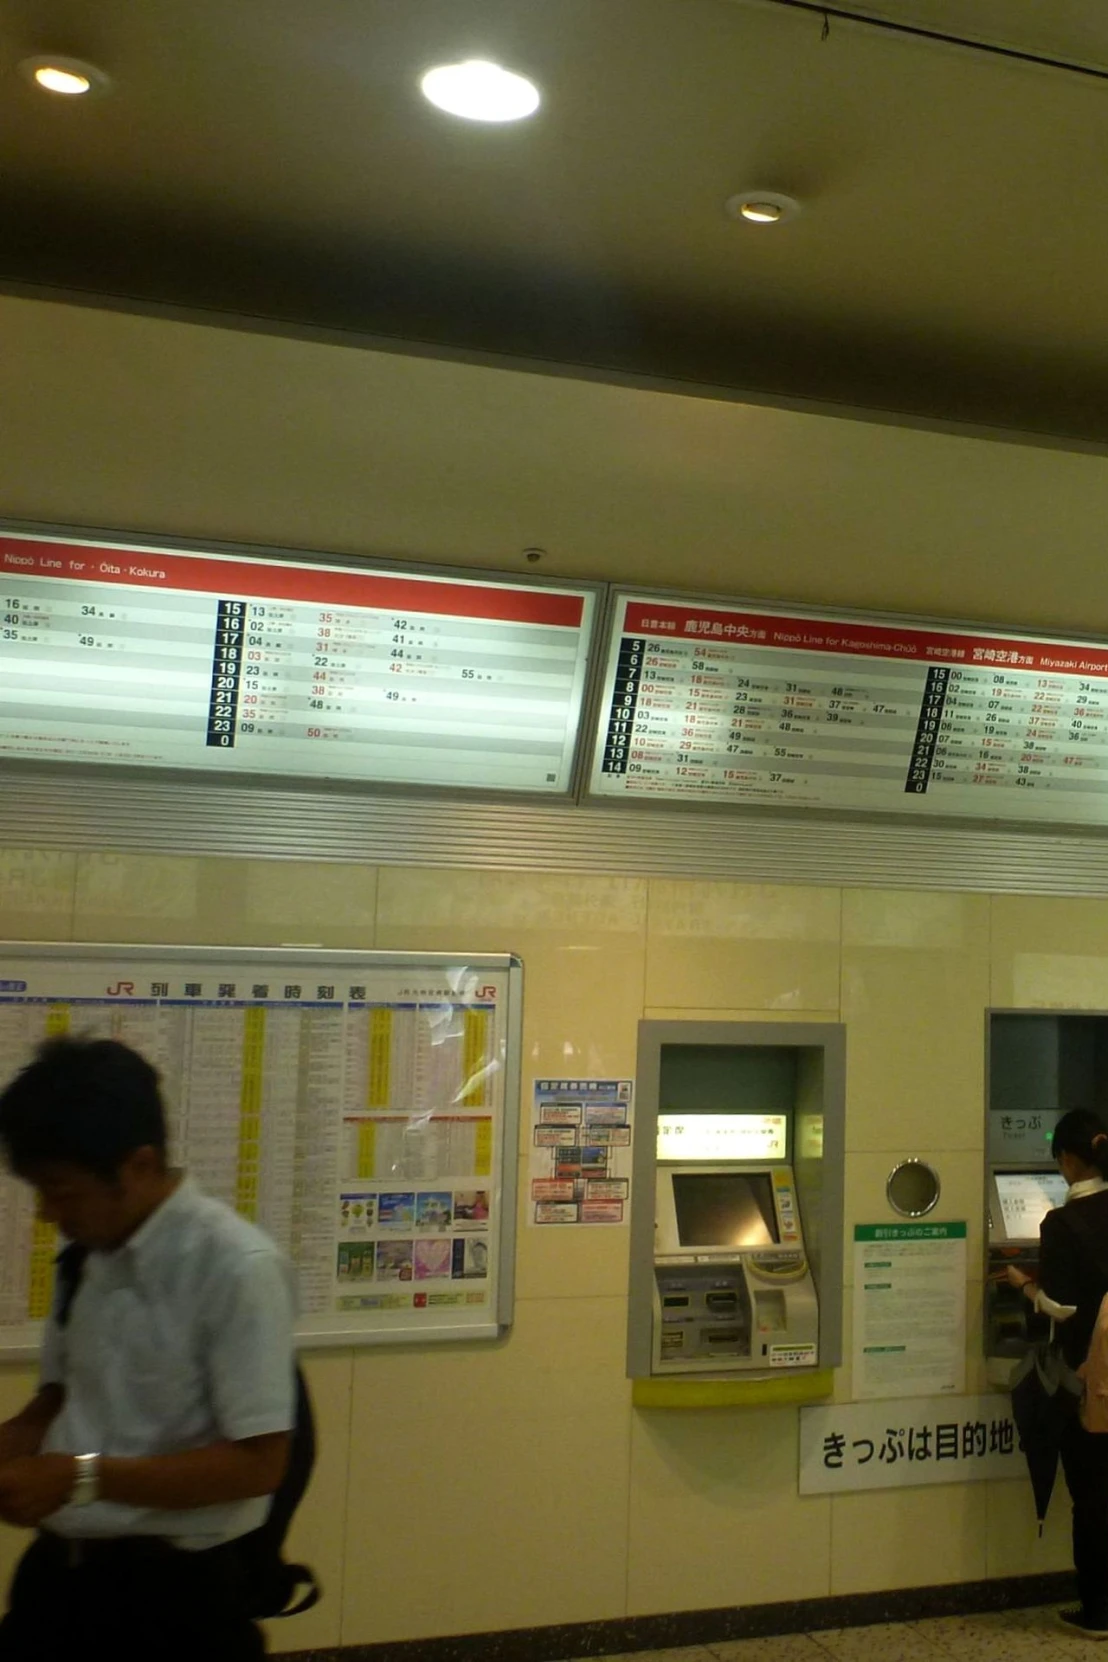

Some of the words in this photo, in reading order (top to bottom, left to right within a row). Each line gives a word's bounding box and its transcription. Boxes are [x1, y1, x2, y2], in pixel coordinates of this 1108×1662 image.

[40, 559, 62, 568] Line
[69, 560, 85, 569] for
[129, 567, 166, 578] Kokura
[5, 600, 19, 609] 16
[82, 606, 95, 615] 34
[4, 614, 18, 625] 40
[225, 603, 241, 615] 15
[252, 607, 265, 617] 13
[319, 613, 332, 622] 35
[394, 620, 407, 630] 42
[3, 630, 18, 640] 35
[80, 636, 94, 646] 49
[223, 618, 240, 630] 16
[250, 622, 264, 631] 02
[318, 628, 330, 637] 38
[392, 635, 404, 644] 41
[223, 633, 238, 644] 17
[249, 637, 262, 646] 04
[316, 643, 328, 652] 31
[391, 649, 403, 658] 44
[632, 641, 640, 651] 5
[648, 644, 660, 652] 26
[694, 648, 706, 656] 54
[803, 635, 823, 645] Line
[826, 638, 839, 646] for
[222, 648, 237, 659] 18
[248, 651, 261, 660] 03
[315, 657, 328, 667] 22
[389, 664, 402, 673] 42
[461, 670, 474, 679] 55
[630, 655, 638, 665] 6
[646, 657, 658, 666] 26
[692, 662, 704, 670] 58
[1040, 658, 1077, 669] Miyazaki
[1079, 662, 1108, 672] Airport
[220, 663, 236, 674] 19
[246, 666, 260, 675] 23
[313, 672, 326, 680] 44
[629, 669, 636, 679] 7
[645, 671, 656, 679] 13
[738, 679, 749, 687] 24
[786, 683, 797, 692] 31
[934, 670, 945, 679] 15
[1079, 683, 1090, 691] 34
[218, 678, 234, 688] 20
[245, 680, 258, 690] 15
[312, 686, 325, 695] 38
[386, 692, 399, 700] 49
[931, 682, 943, 691] 16
[1034, 692, 1045, 700] 22
[216, 692, 232, 703] 21
[244, 696, 257, 704] 20
[310, 700, 323, 710] 48
[624, 696, 632, 706] 9
[686, 702, 697, 710] 21
[734, 706, 745, 714] 28
[626, 682, 634, 693] 8
[642, 684, 654, 692] 00
[736, 693, 747, 701] 23
[829, 700, 841, 708] 37
[873, 705, 884, 713] 47
[929, 696, 940, 704] 17
[215, 707, 231, 717] 22
[242, 710, 255, 718] 35
[616, 709, 630, 719] 10
[638, 711, 649, 719] 03
[732, 718, 742, 727] 21
[926, 708, 938, 717] 18
[986, 713, 997, 721] 26
[1029, 717, 1039, 725] 37
[214, 721, 230, 732] 23
[241, 723, 254, 732] 09
[308, 729, 320, 737] 50
[614, 722, 626, 732] 11
[635, 725, 647, 733] 22
[923, 721, 935, 730] 19
[221, 735, 229, 745] 0
[612, 735, 626, 745] 12
[635, 738, 645, 746] 10
[680, 741, 691, 749] 29
[727, 745, 739, 753] 47
[920, 734, 933, 742] 20
[610, 748, 623, 759] 13
[678, 754, 688, 762] 31
[918, 746, 929, 755] 21
[915, 759, 927, 767] 22
[608, 762, 621, 772] 14
[630, 764, 642, 772] 09
[676, 767, 688, 775] 12
[770, 774, 782, 782] 37
[913, 771, 924, 779] 23
[916, 783, 922, 791] 0
[107, 982, 135, 996] JR
[152, 982, 366, 1000] 列車発着時刻表
[475, 986, 496, 997] JR
